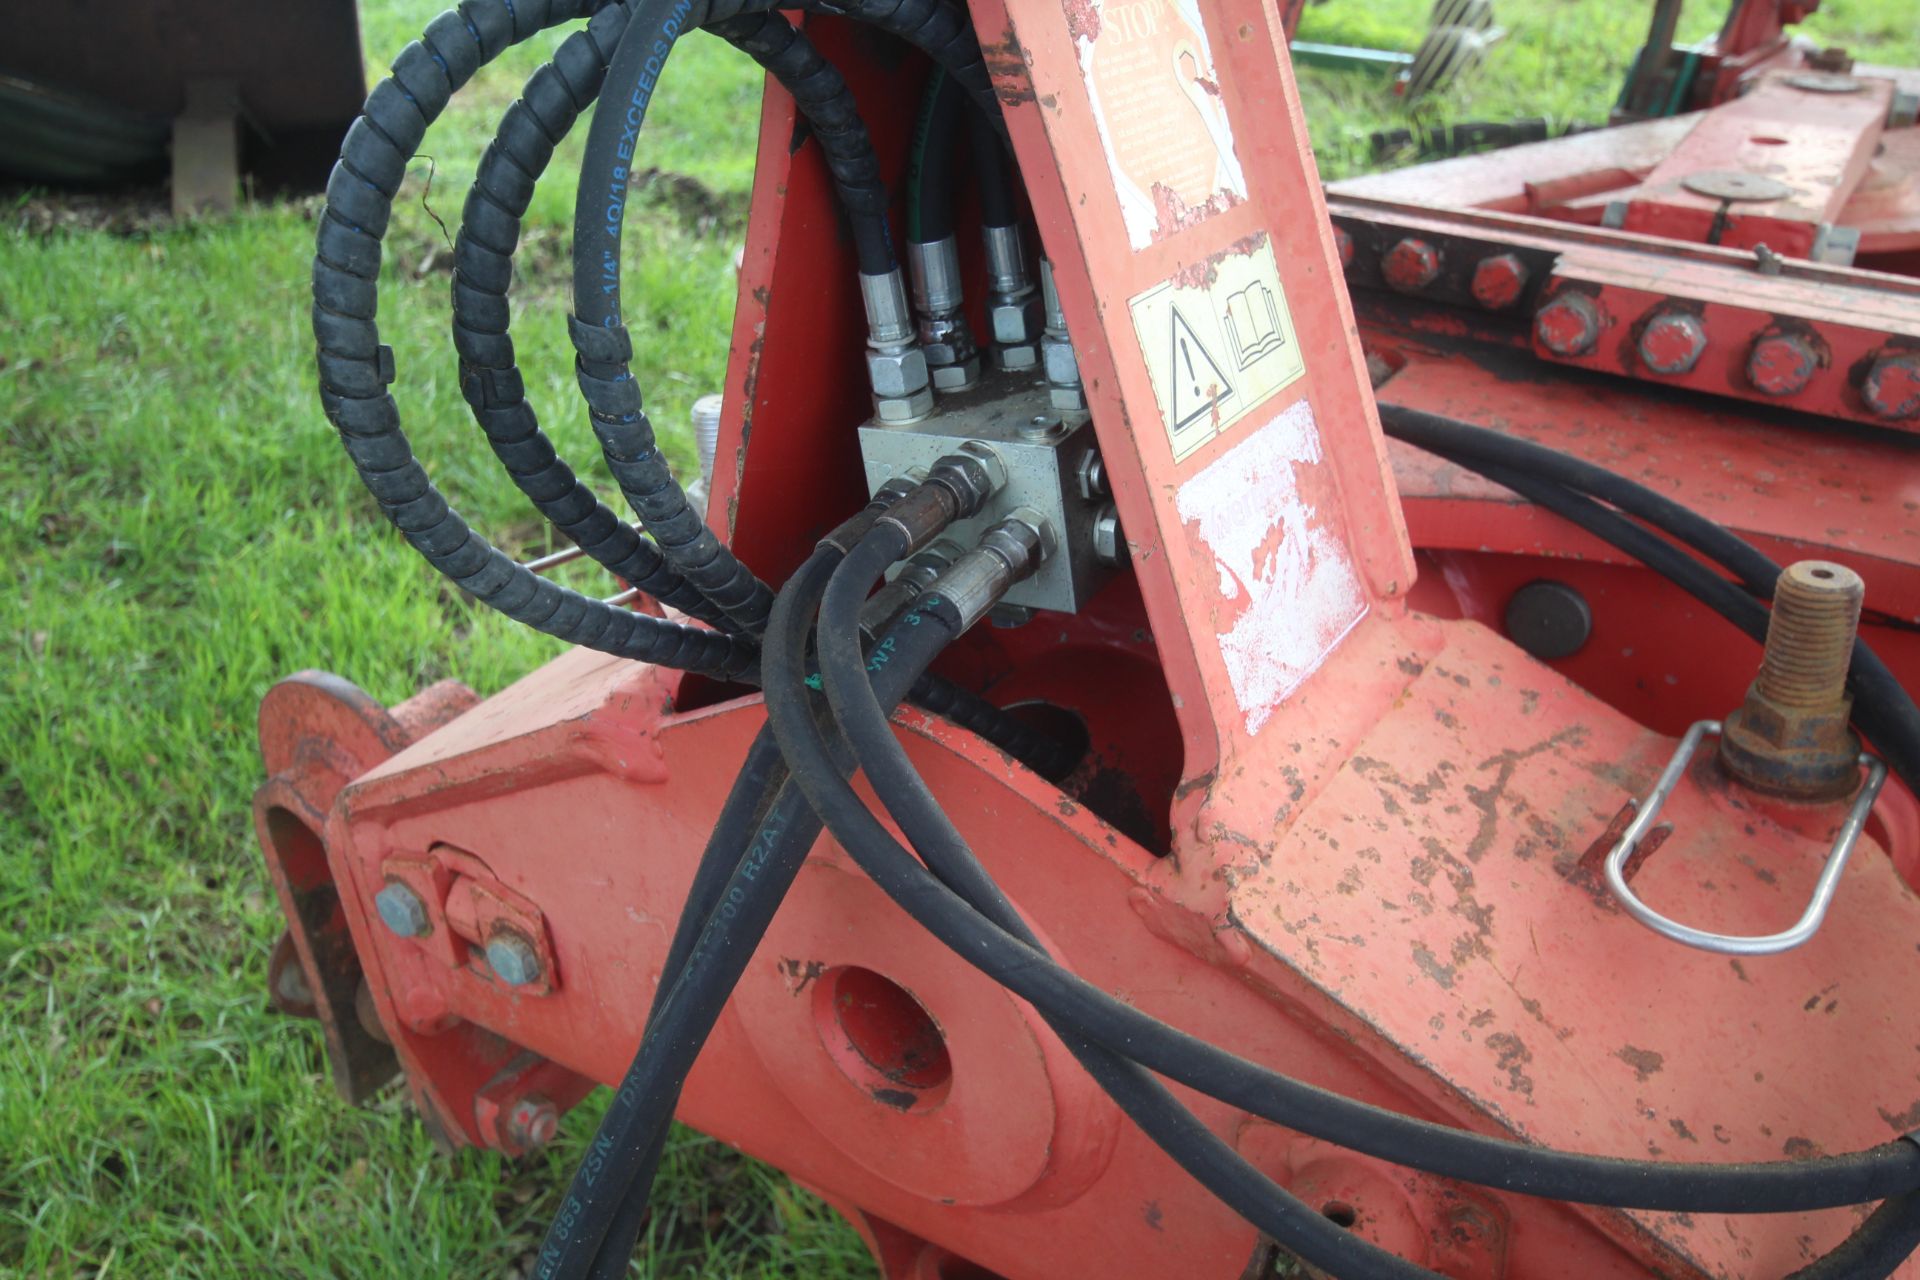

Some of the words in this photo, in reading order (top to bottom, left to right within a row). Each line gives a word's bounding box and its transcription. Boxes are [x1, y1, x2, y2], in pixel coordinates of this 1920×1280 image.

[616, 38, 670, 161] EXCEEDS
[606, 167, 628, 239] 4Q/18
[556, 1198, 581, 1241] 853
[581, 1134, 613, 1187] 2SN
[741, 809, 790, 882] R2AT
